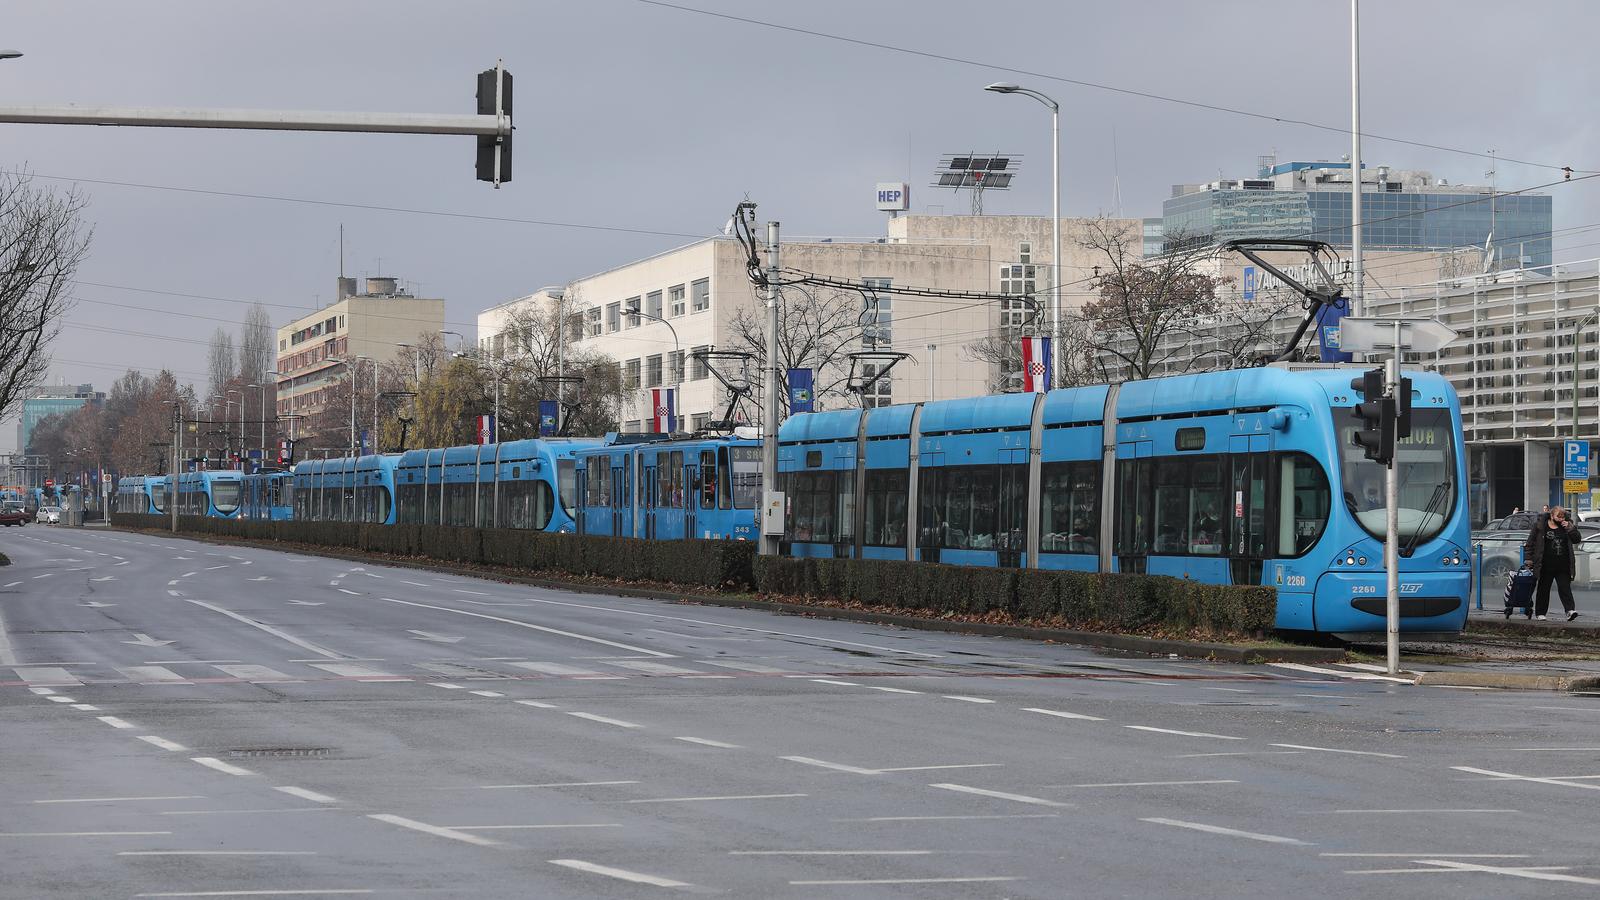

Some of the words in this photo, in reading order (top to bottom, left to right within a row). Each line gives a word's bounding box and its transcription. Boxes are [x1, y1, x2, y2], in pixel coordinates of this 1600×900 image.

[878, 191, 901, 202] HEP
[1567, 443, 1580, 462] P
[1286, 575, 1306, 587] 2260
[1351, 585, 1376, 594] 2260
[1400, 583, 1424, 593] ZET
